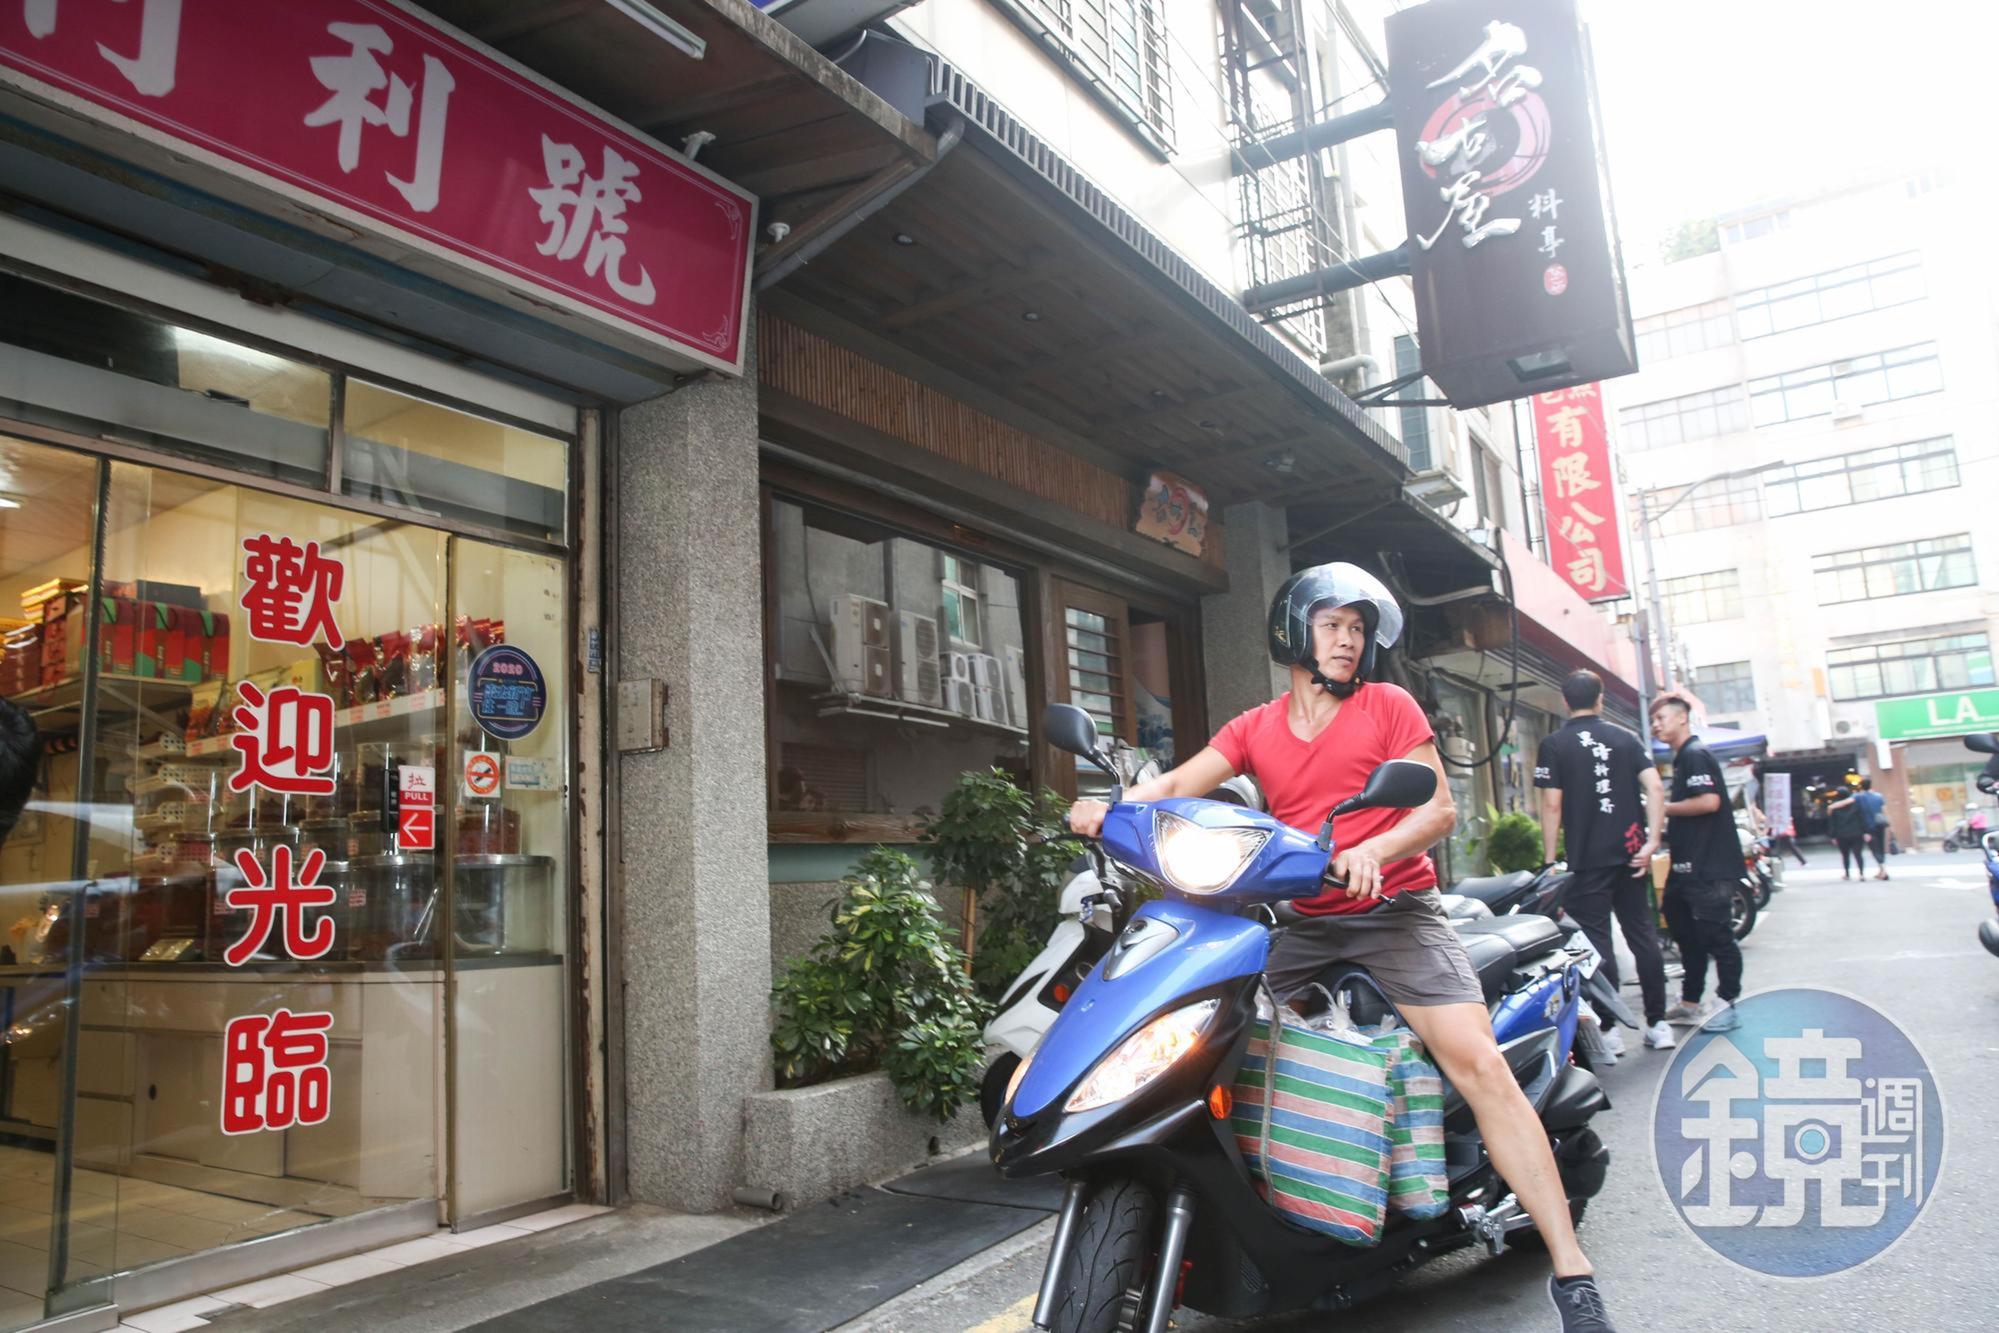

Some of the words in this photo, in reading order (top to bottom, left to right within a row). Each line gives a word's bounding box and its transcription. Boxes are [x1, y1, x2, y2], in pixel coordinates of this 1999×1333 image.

[1527, 188, 1565, 258] 料亭
[1546, 405, 1607, 592] 有限公司
[493, 662, 523, 675] 2020
[404, 791, 429, 801] PULL
[408, 772, 426, 789] 拉
[221, 533, 345, 1135] 歡迎光臨
